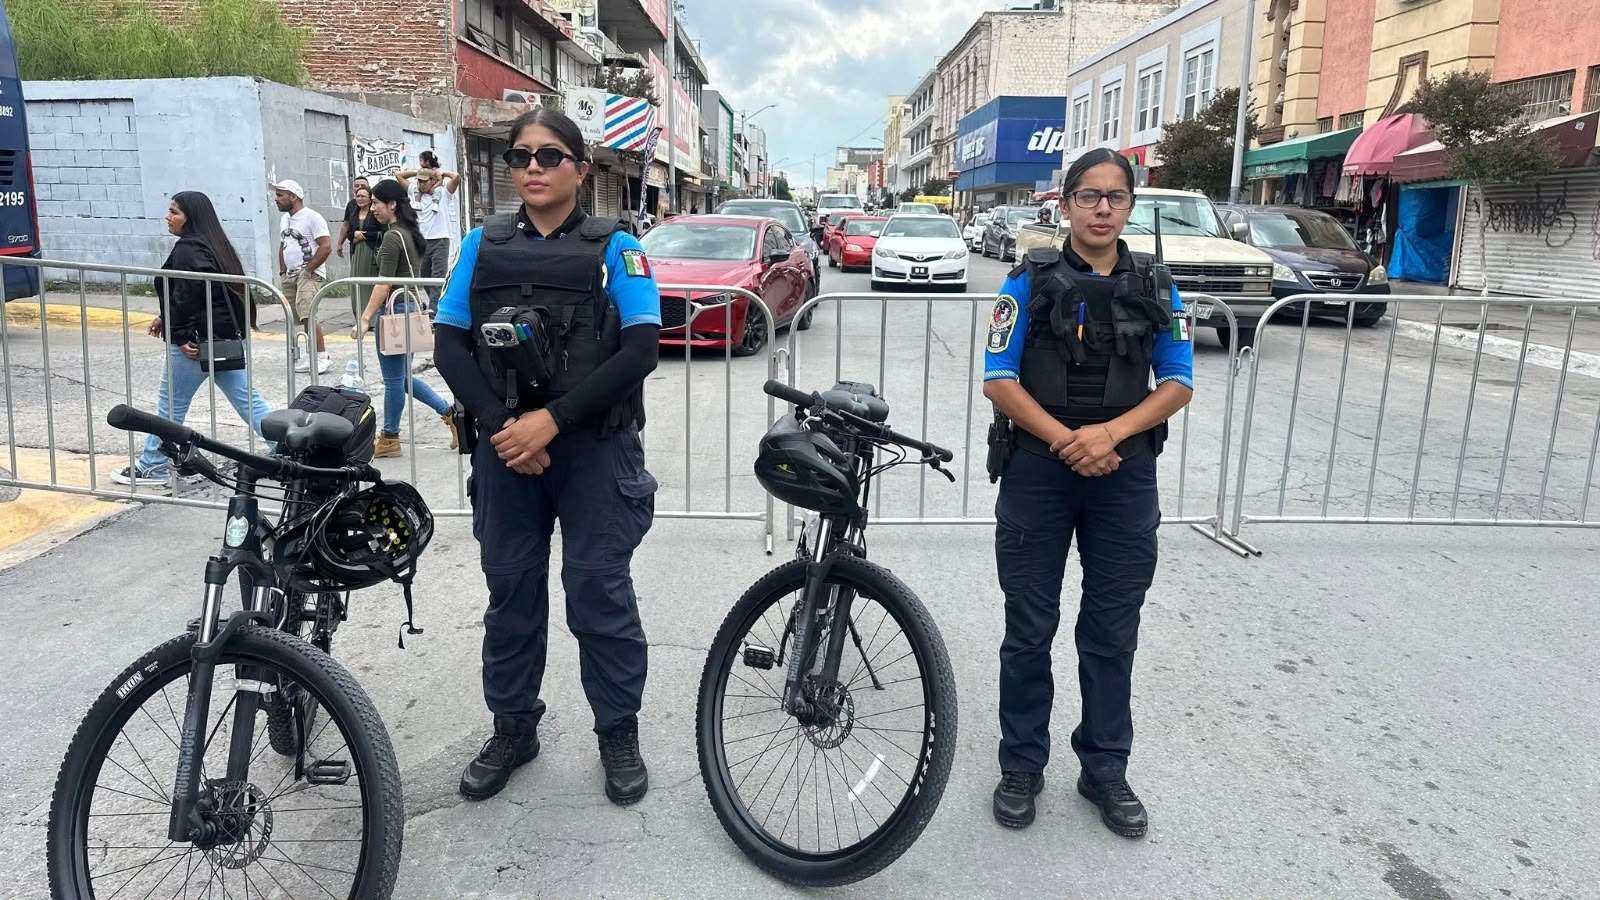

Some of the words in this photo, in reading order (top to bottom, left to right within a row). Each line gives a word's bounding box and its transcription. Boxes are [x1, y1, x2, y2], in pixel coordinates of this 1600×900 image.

[367, 152, 400, 170] BARBER
[0, 192, 24, 207] 2195
[116, 671, 144, 699] IKON
[913, 711, 936, 796] MAXXIS
